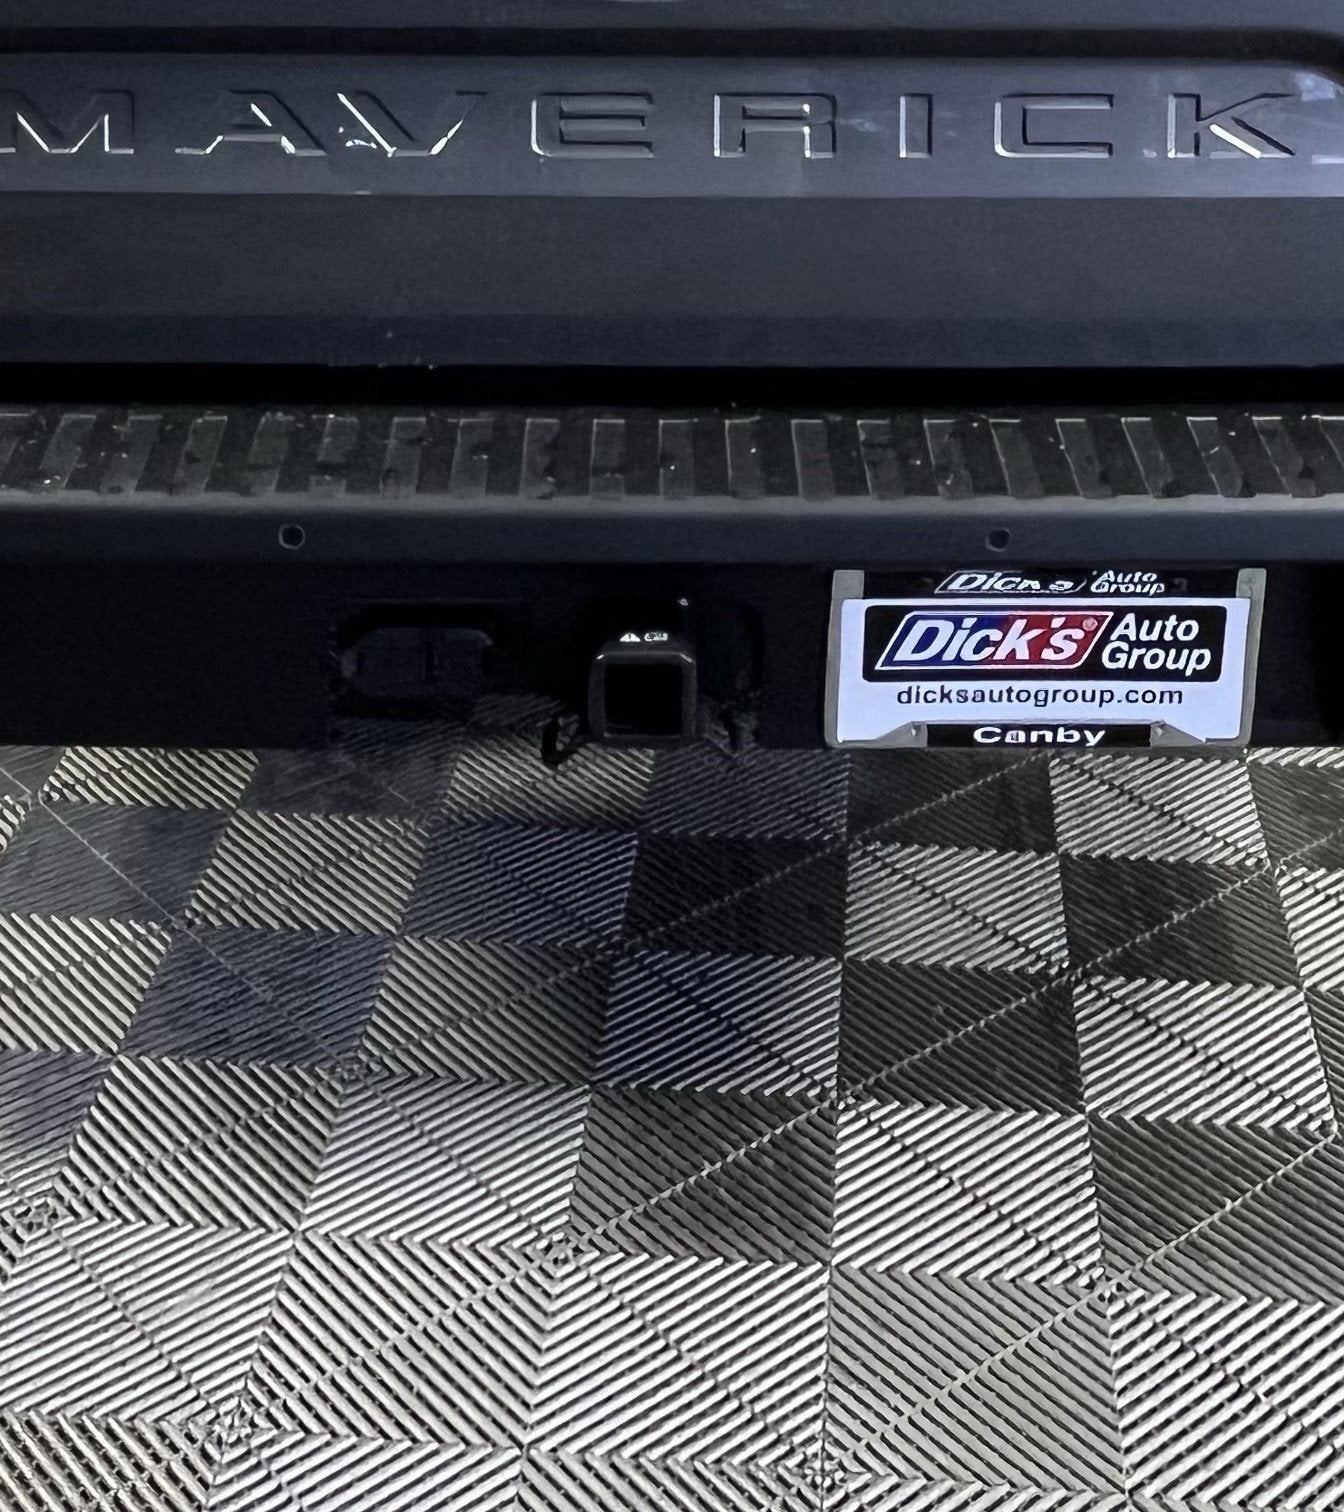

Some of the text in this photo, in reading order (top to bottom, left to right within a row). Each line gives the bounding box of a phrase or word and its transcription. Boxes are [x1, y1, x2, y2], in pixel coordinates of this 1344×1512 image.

[893, 616, 1087, 662] Dick's
[1109, 613, 1200, 642] Auto
[1102, 641, 1212, 677] Group
[896, 685, 1184, 708] dicksautogroup.com
[972, 725, 1106, 747] Canby
